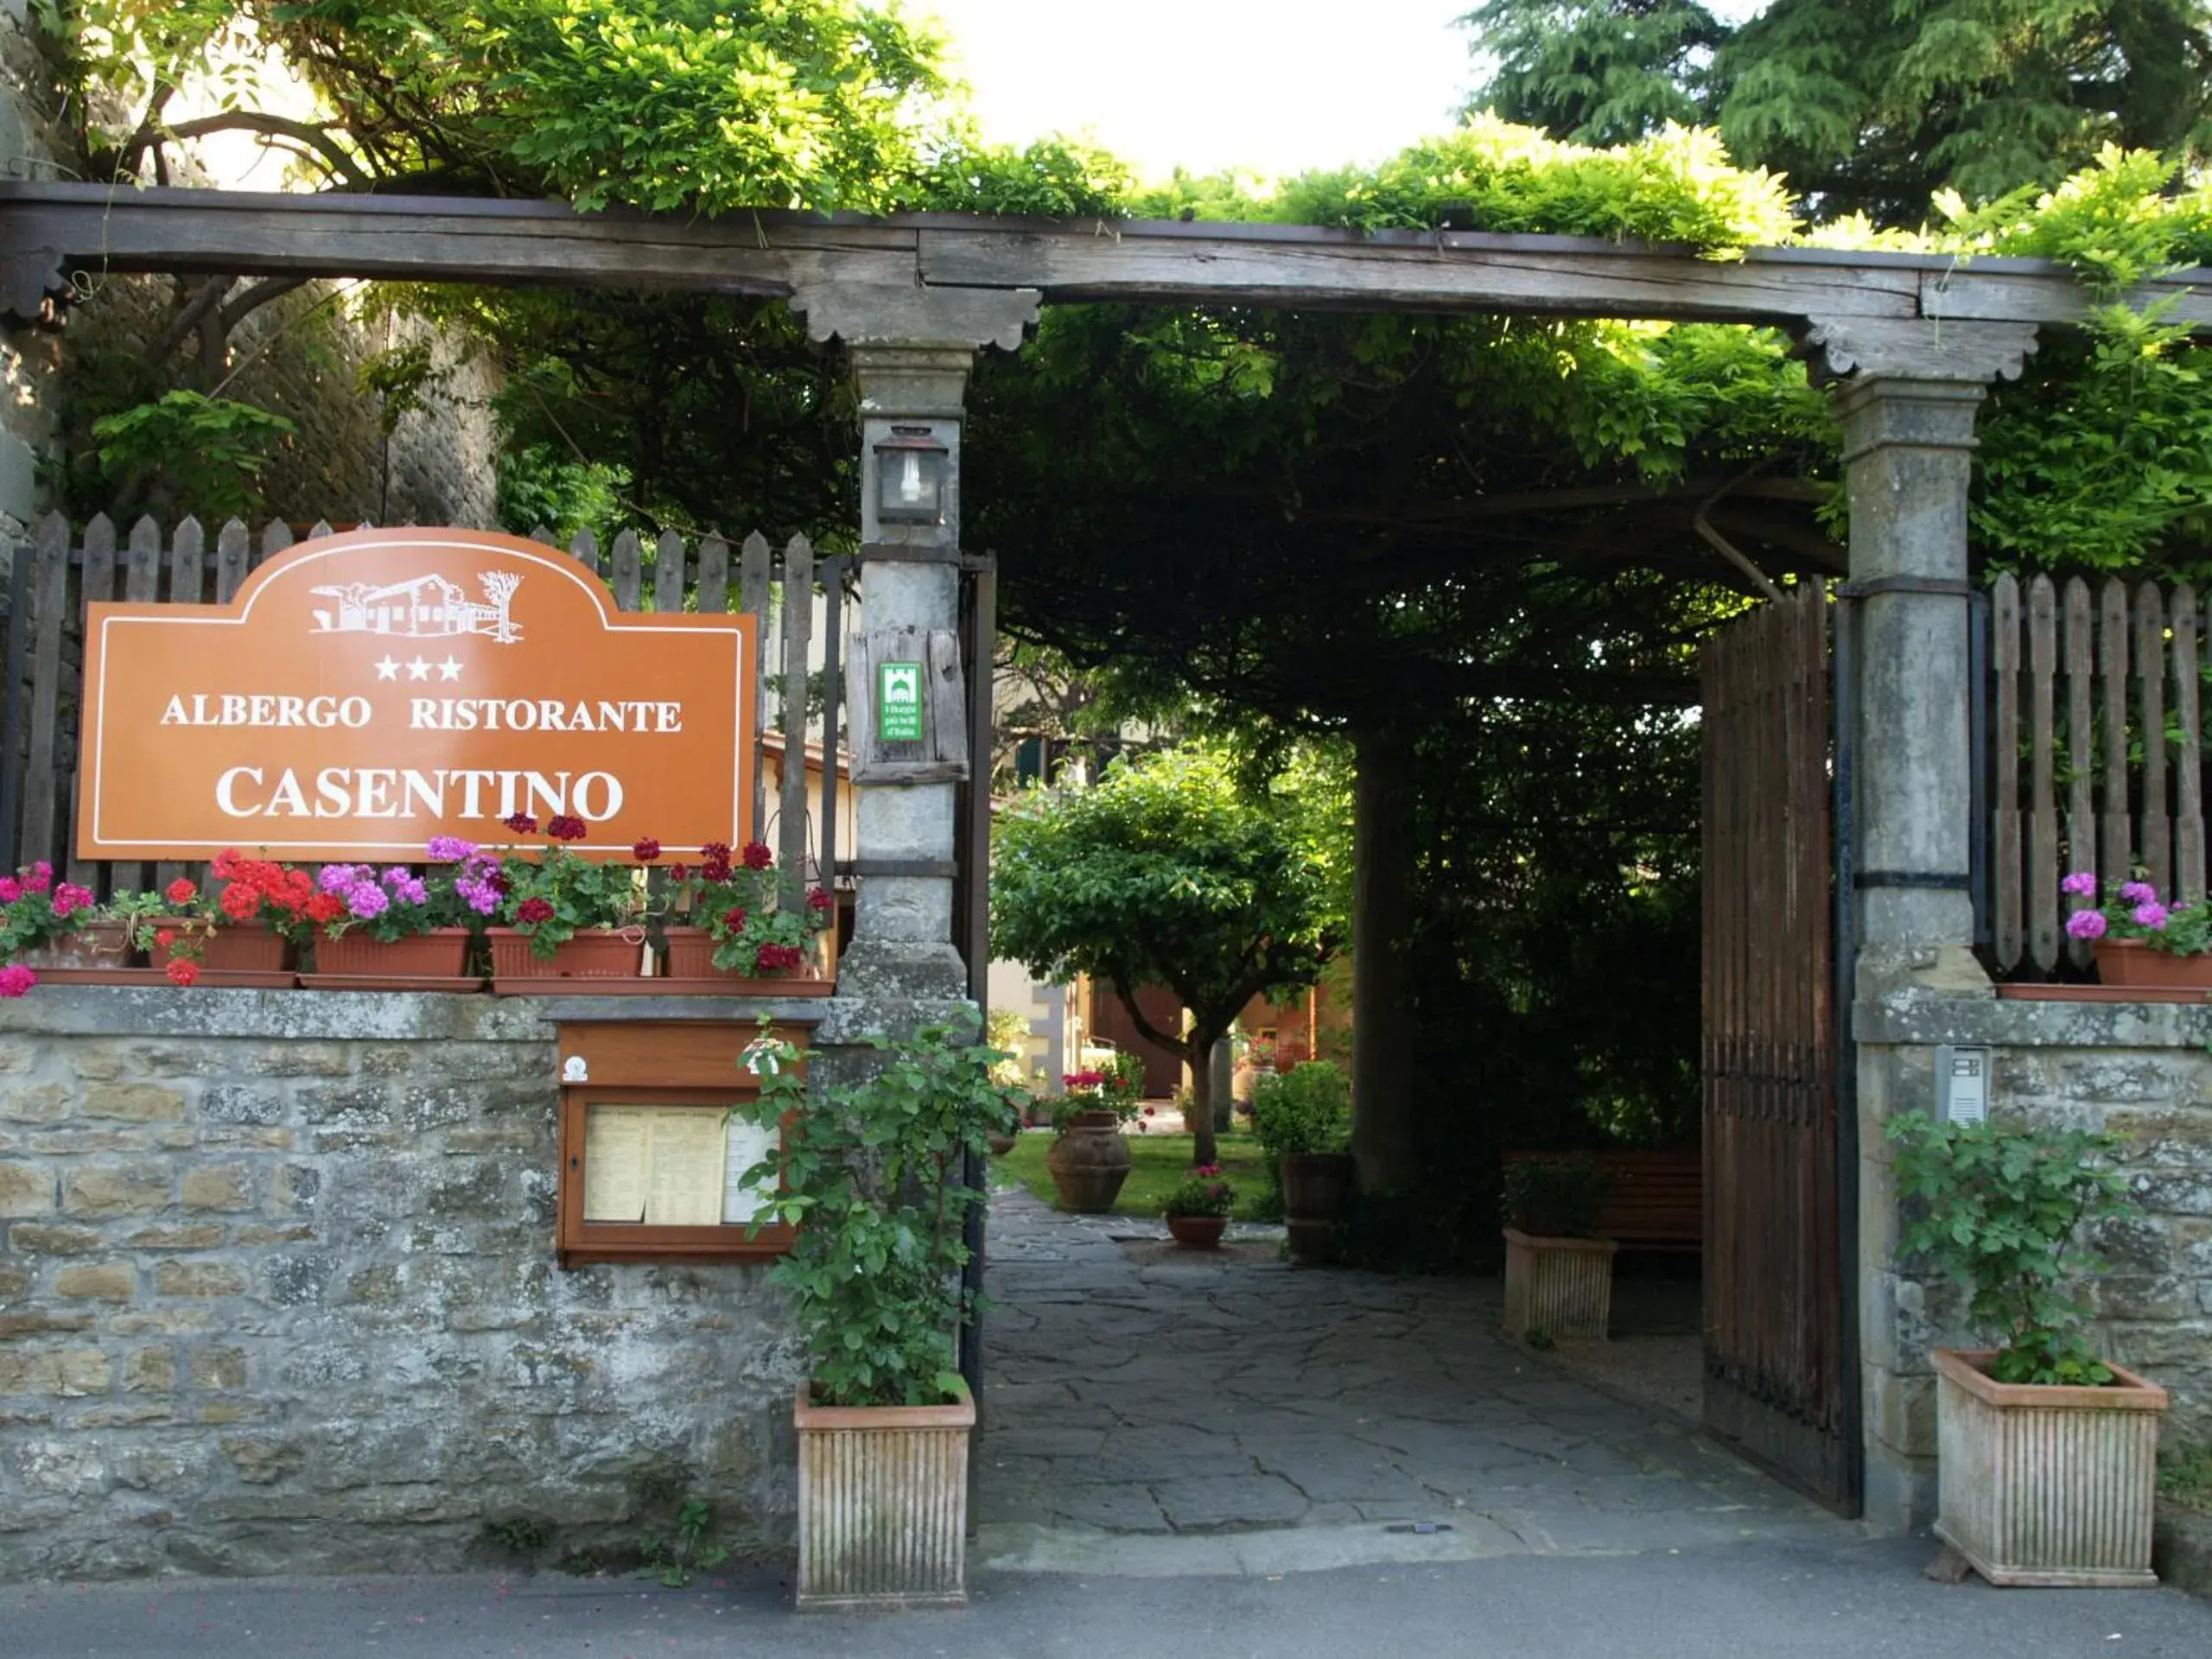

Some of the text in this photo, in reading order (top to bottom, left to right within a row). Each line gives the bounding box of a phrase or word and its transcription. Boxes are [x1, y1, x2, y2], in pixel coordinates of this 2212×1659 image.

[161, 694, 682, 733] ALBERGO RISTORANTE
[215, 766, 624, 822] CASENTINO
